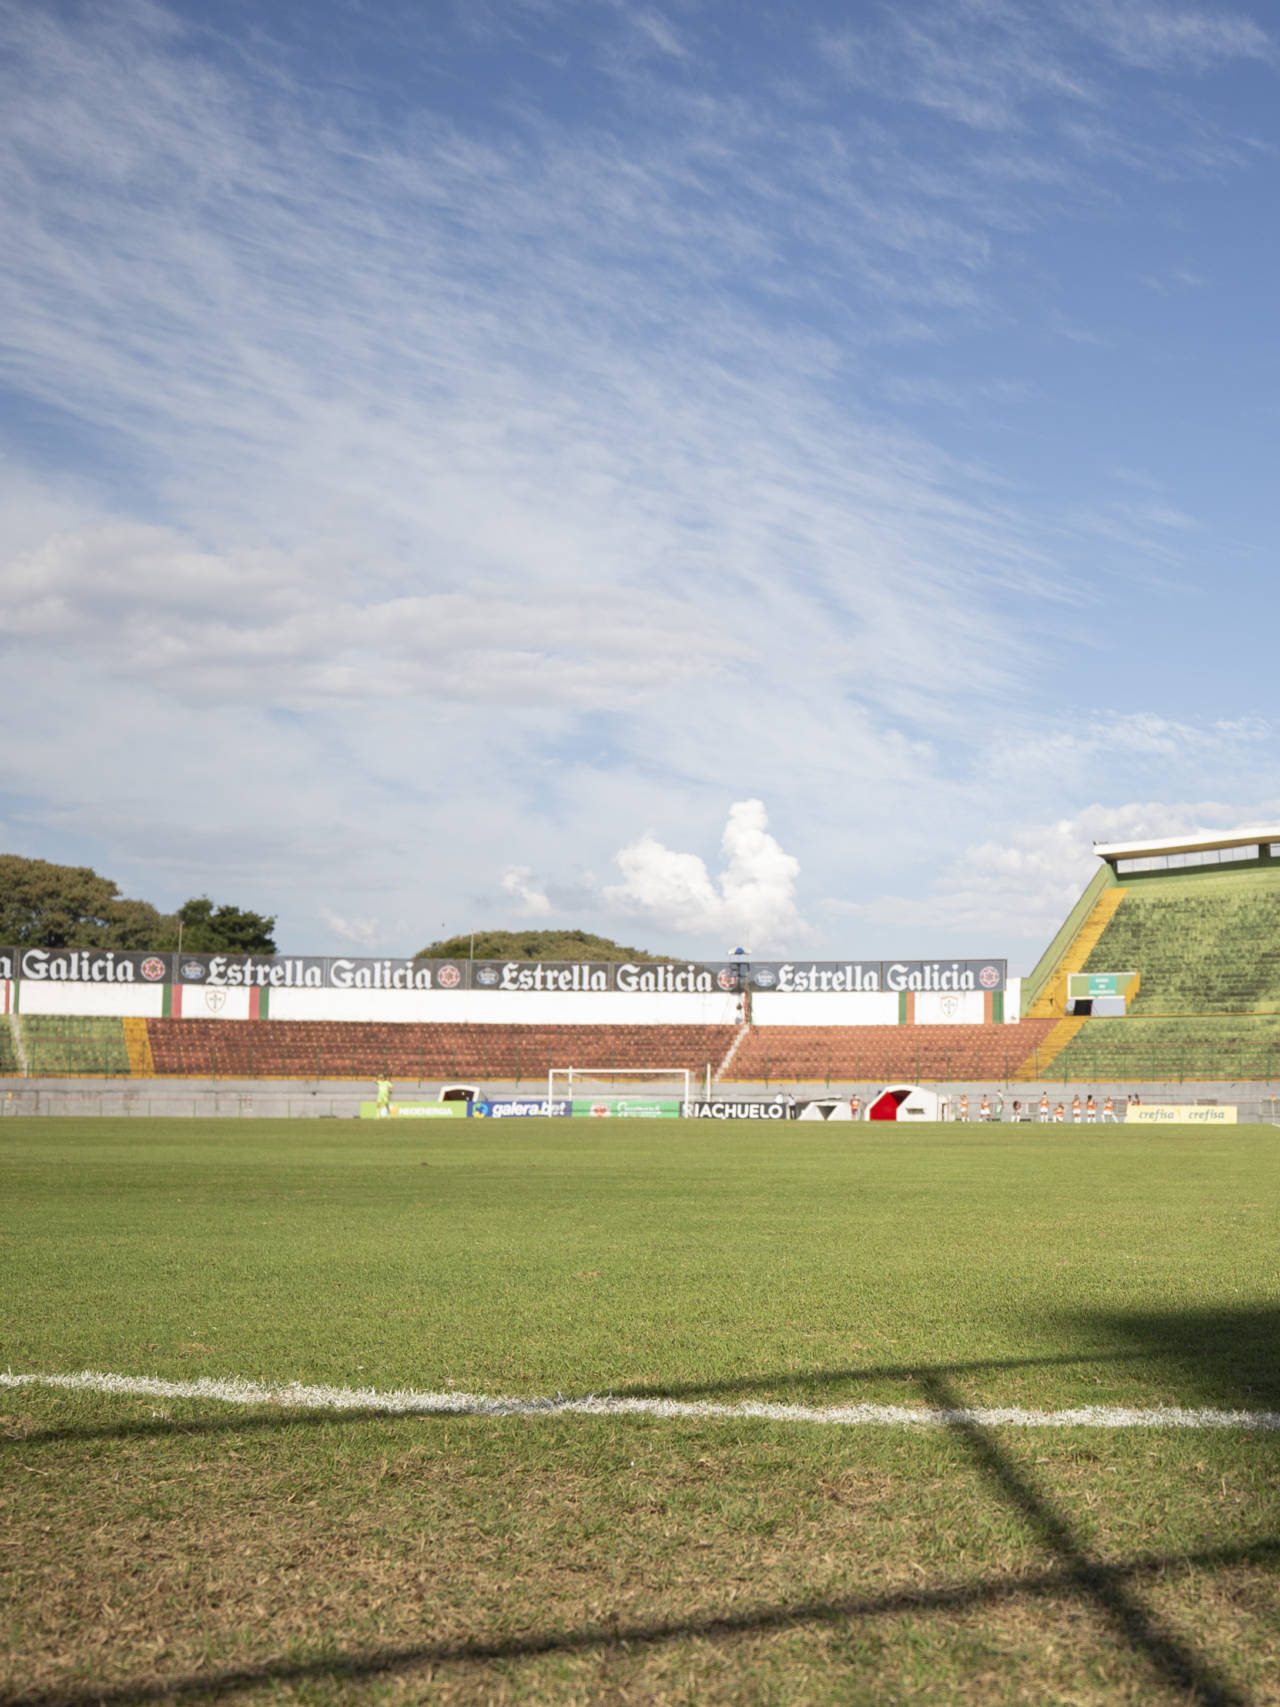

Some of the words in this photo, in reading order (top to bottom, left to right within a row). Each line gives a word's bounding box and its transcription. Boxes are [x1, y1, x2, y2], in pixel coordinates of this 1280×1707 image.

[22, 949, 135, 982] Galicia
[205, 956, 322, 986] Estrella
[330, 959, 432, 989] Galicia
[499, 962, 607, 991] Estrella
[617, 963, 712, 992] Galicia
[776, 964, 880, 992] Estrella
[887, 964, 976, 991] Galicia
[682, 1103, 783, 1118] RIACHUELO
[1139, 1109, 1174, 1121] crefisa
[1189, 1108, 1225, 1121] crefisa
